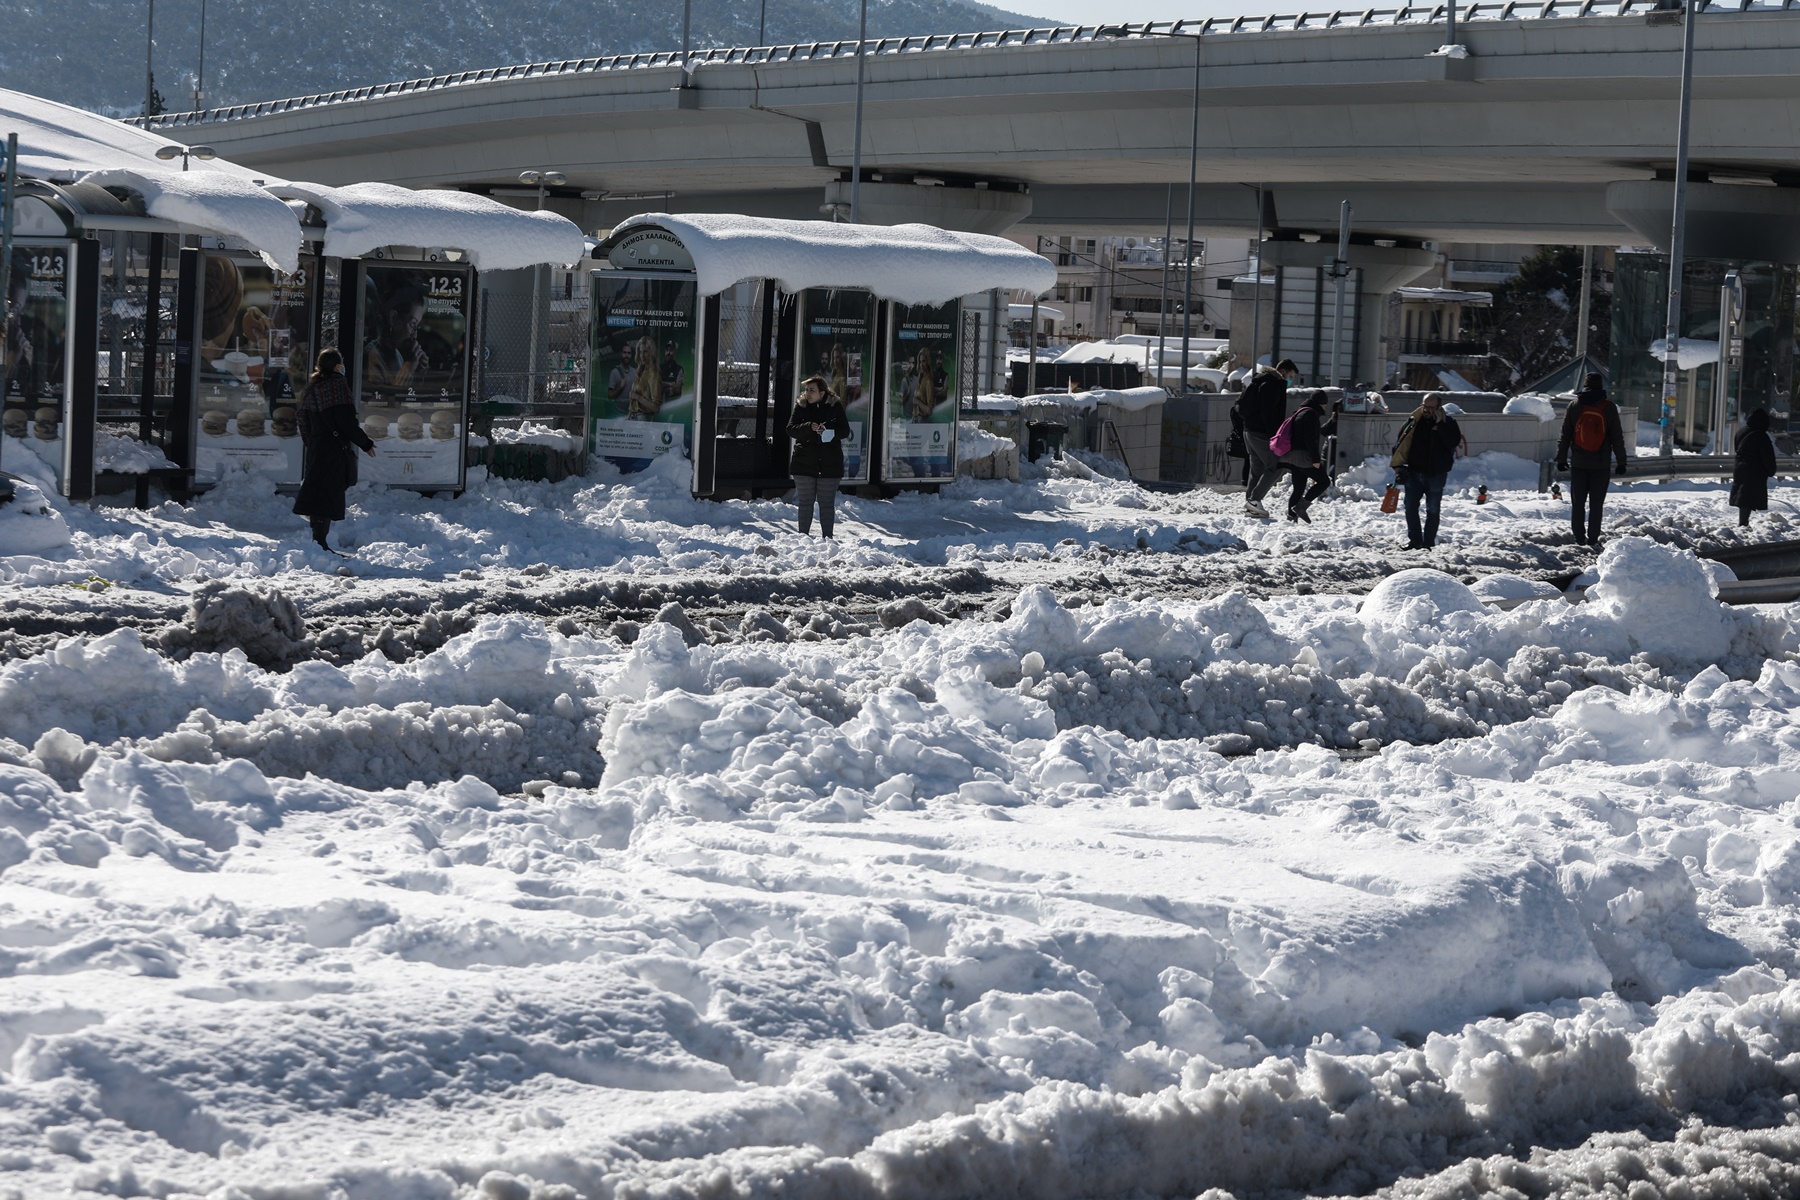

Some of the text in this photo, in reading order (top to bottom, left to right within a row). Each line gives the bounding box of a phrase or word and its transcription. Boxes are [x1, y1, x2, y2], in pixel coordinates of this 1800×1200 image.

[622, 233, 685, 250] ΔΗΜΟΣ ΧΑΛΑΝΔΡΙΟΥ
[31, 255, 64, 277] 1,2,3
[272, 268, 306, 288] 1,2,3
[429, 276, 462, 296] 1,2,3
[606, 317, 689, 328] INTERNET ΤΟΥ ΣΠΙΤΙΟΥ ΣΟΥ!
